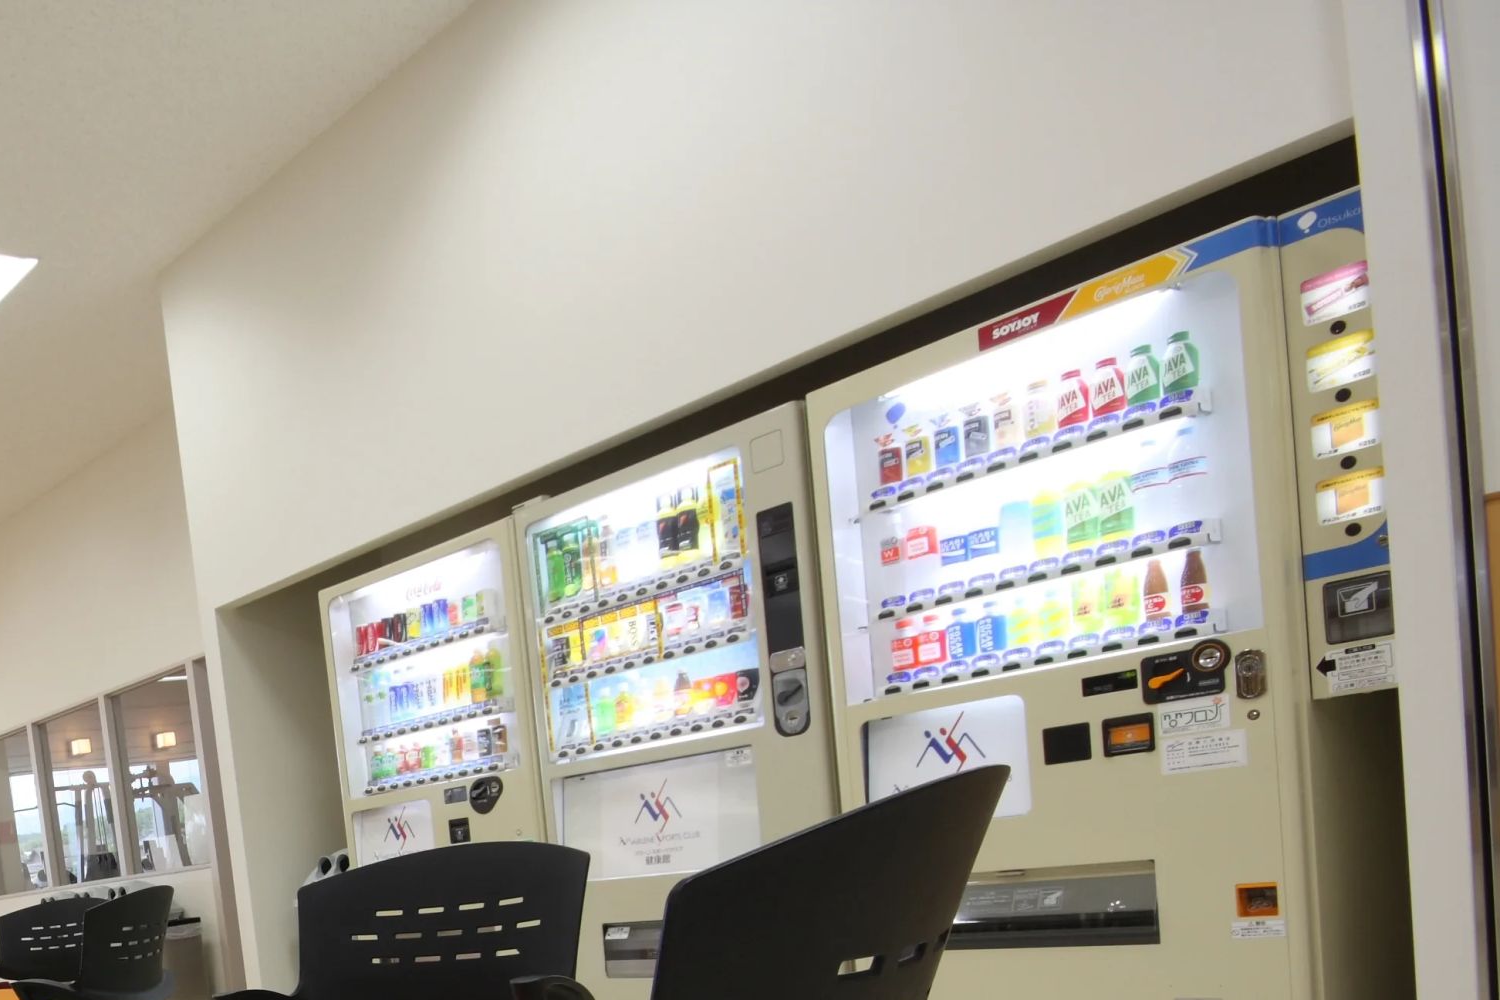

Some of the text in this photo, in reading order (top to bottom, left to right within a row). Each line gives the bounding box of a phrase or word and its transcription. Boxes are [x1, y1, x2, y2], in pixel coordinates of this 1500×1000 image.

[1317, 207, 1362, 228] Otsuka
[992, 311, 1040, 340] SOYJOY
[1066, 491, 1091, 516] AVA
[1100, 482, 1126, 508] AVA
